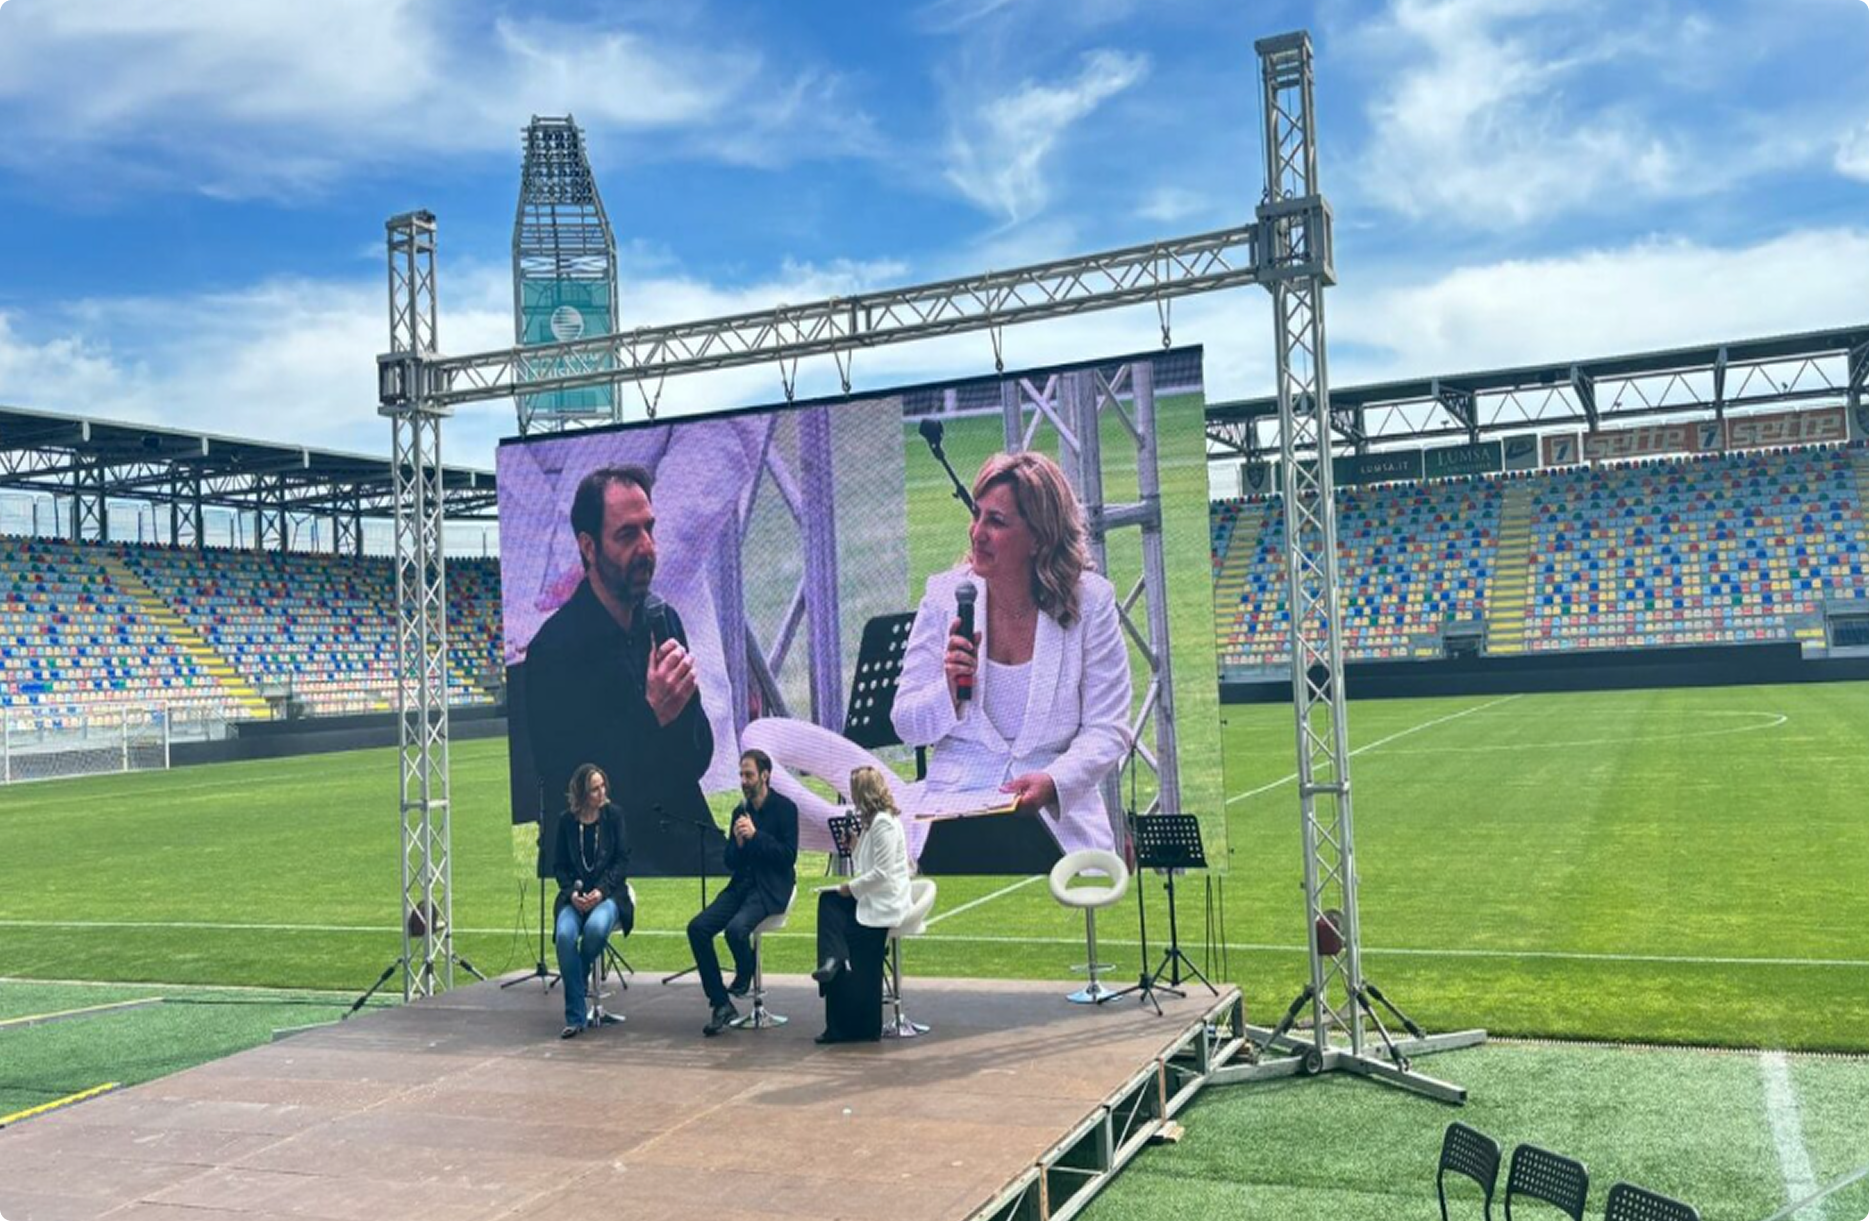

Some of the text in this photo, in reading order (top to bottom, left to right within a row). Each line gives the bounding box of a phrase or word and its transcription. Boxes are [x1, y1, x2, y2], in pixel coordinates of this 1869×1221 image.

[1700, 413, 1841, 447] 7 sette
[1553, 427, 1687, 460] 7 sette
[1361, 461, 1408, 475] LUMSA.IT
[1438, 448, 1491, 467] LUMSA
